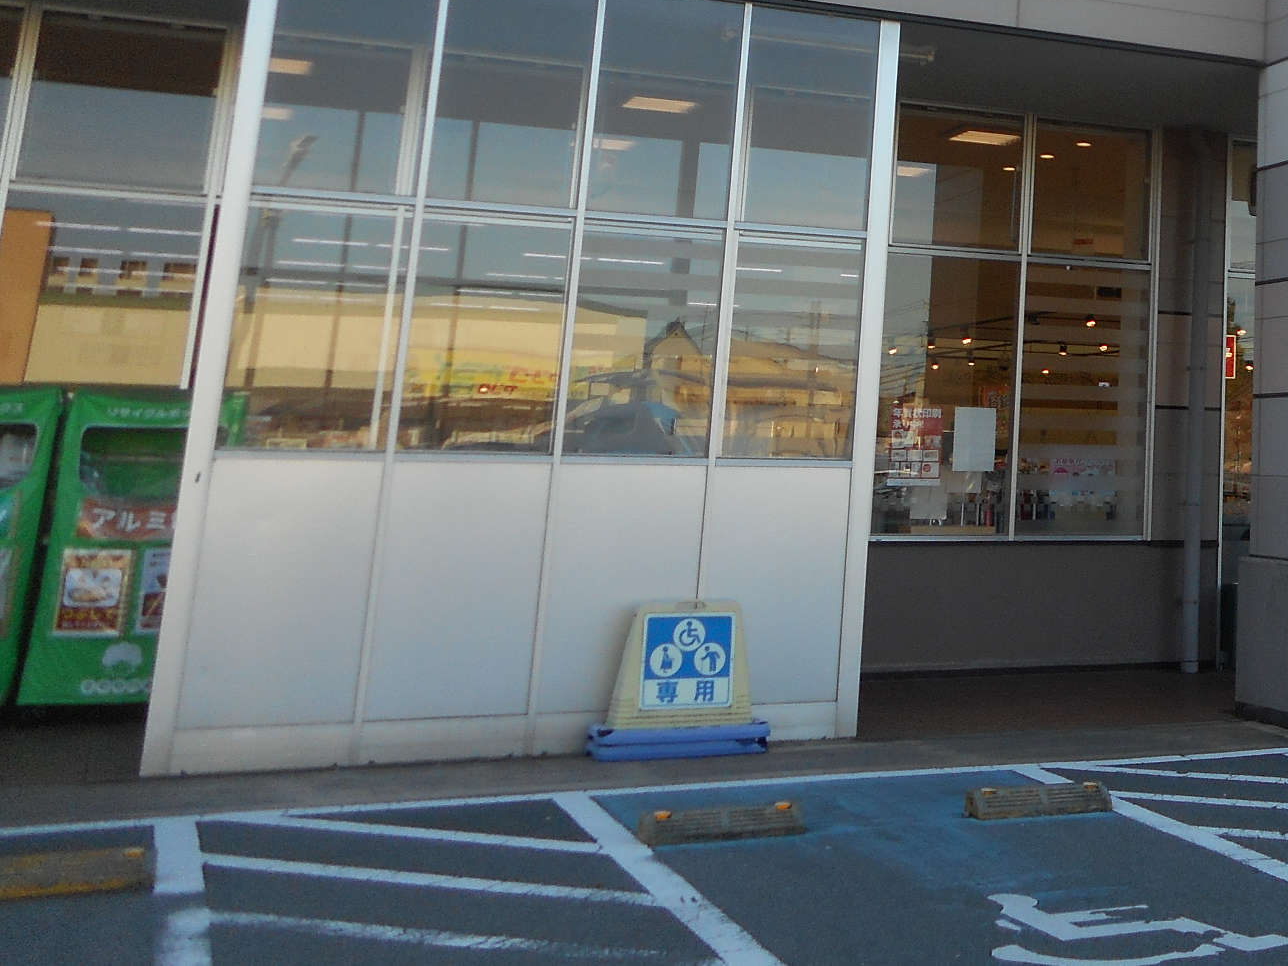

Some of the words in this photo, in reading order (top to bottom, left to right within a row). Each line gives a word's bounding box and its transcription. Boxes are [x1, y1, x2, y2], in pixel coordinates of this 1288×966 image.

[91, 507, 177, 533] アルミ
[656, 679, 715, 703] 専用
